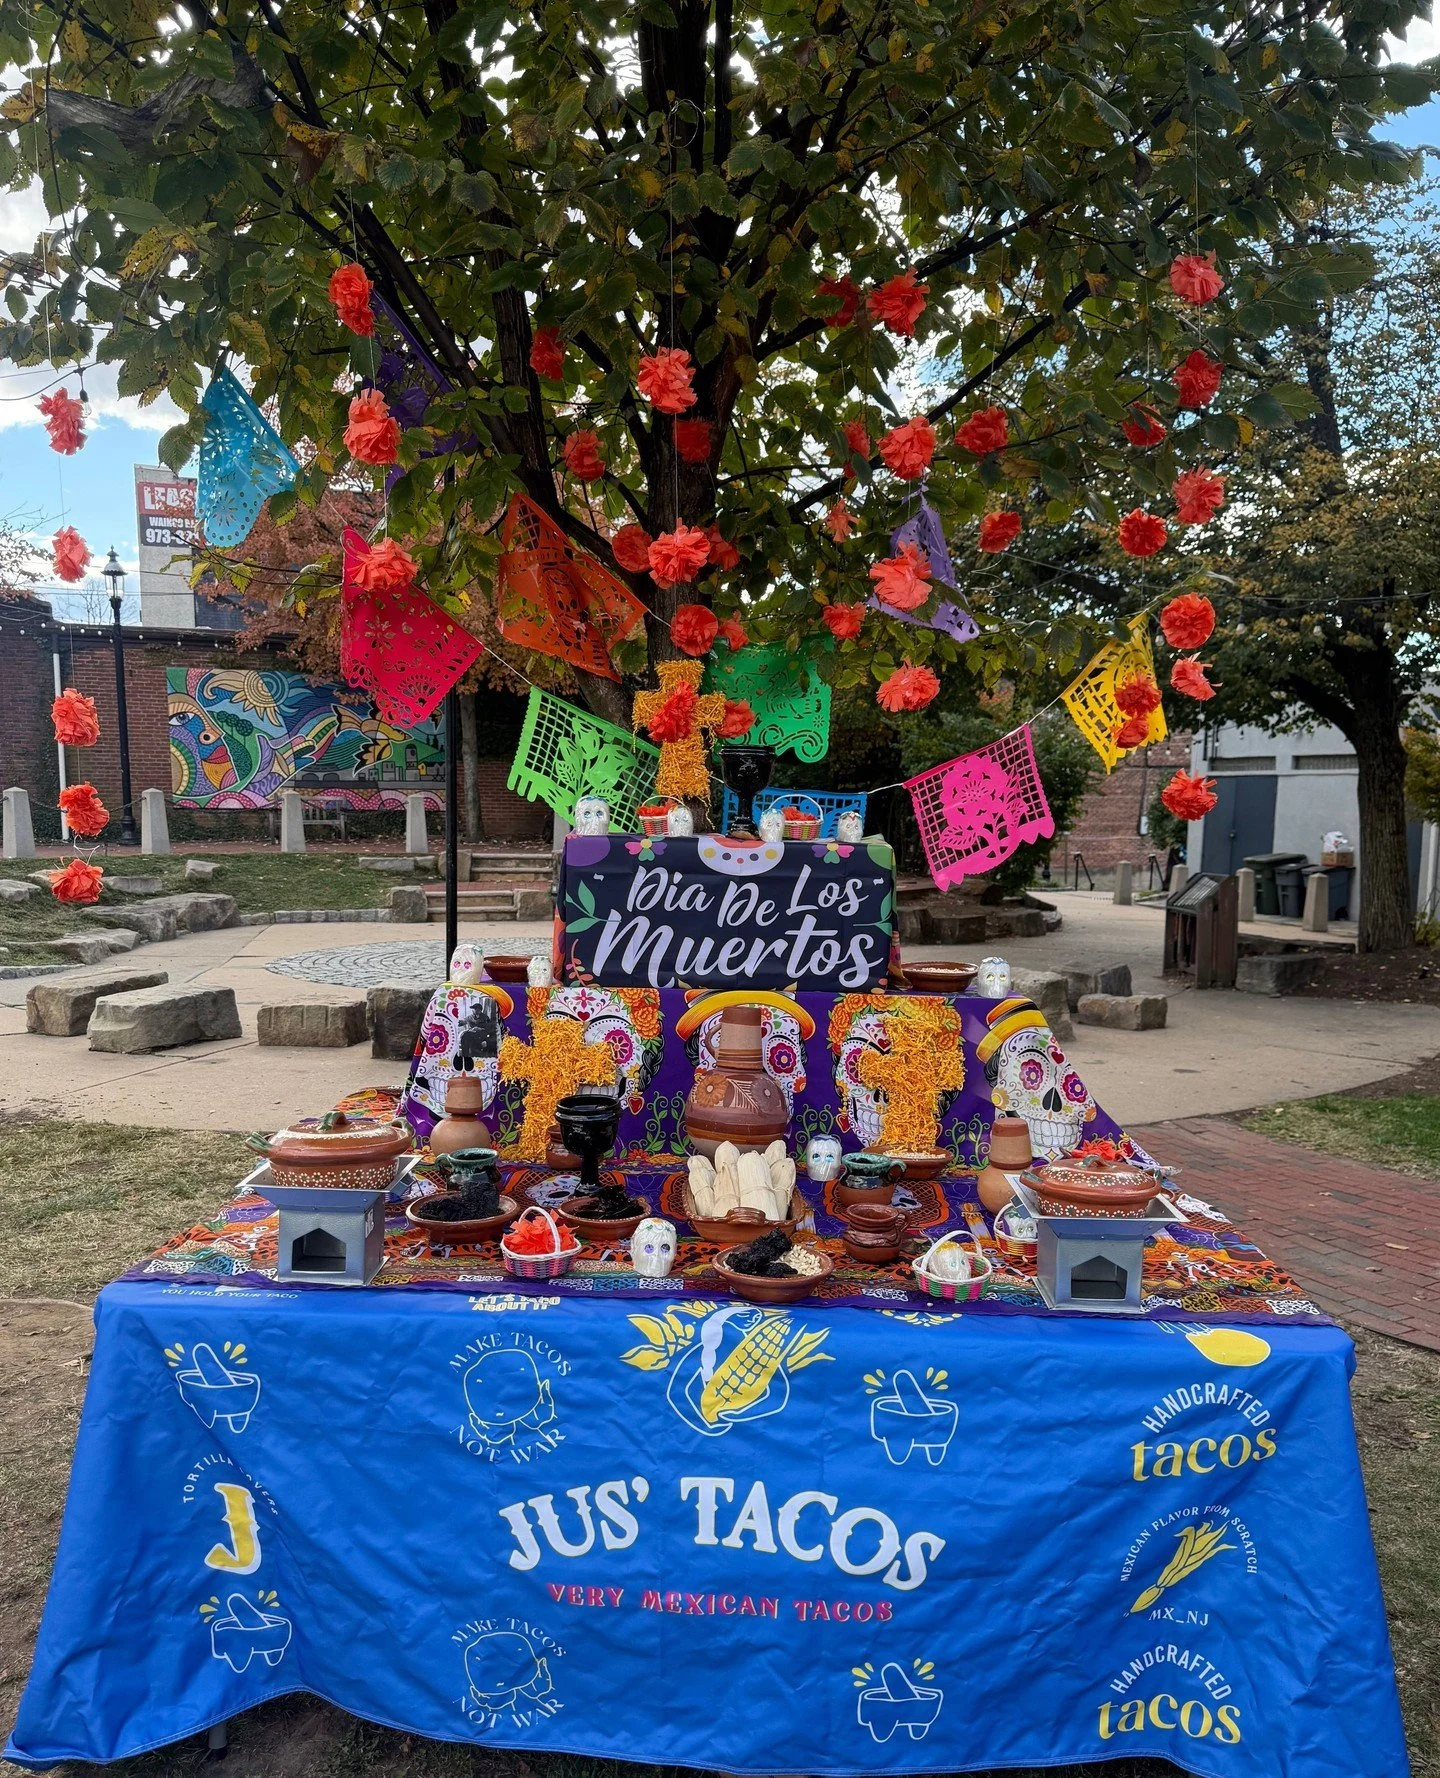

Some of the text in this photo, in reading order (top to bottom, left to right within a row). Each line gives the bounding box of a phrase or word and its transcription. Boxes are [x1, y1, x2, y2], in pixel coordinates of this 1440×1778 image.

[626, 864, 870, 928] Dia De Los
[592, 908, 884, 989] Muertos
[472, 1301, 530, 1312] ABOUT
[449, 1332, 572, 1376] MAKE TACOS
[1141, 1382, 1271, 1433] HANDCRAFTED
[449, 1424, 567, 1464] NOT WAR
[1130, 1428, 1277, 1482] tacos
[183, 1453, 234, 1504] TORTILLA
[680, 1476, 946, 1591] TACOS
[1120, 1504, 1258, 1583] MEXICAN FLAVOR FROM SCRATCH
[547, 1583, 894, 1622] VERY MEXICAN TACOS
[451, 1617, 567, 1657] MAKE TACOS
[1110, 1643, 1232, 1701] HANDCRAFTED
[452, 1695, 565, 1729] NOT WAR
[1097, 1693, 1242, 1744] tacos
